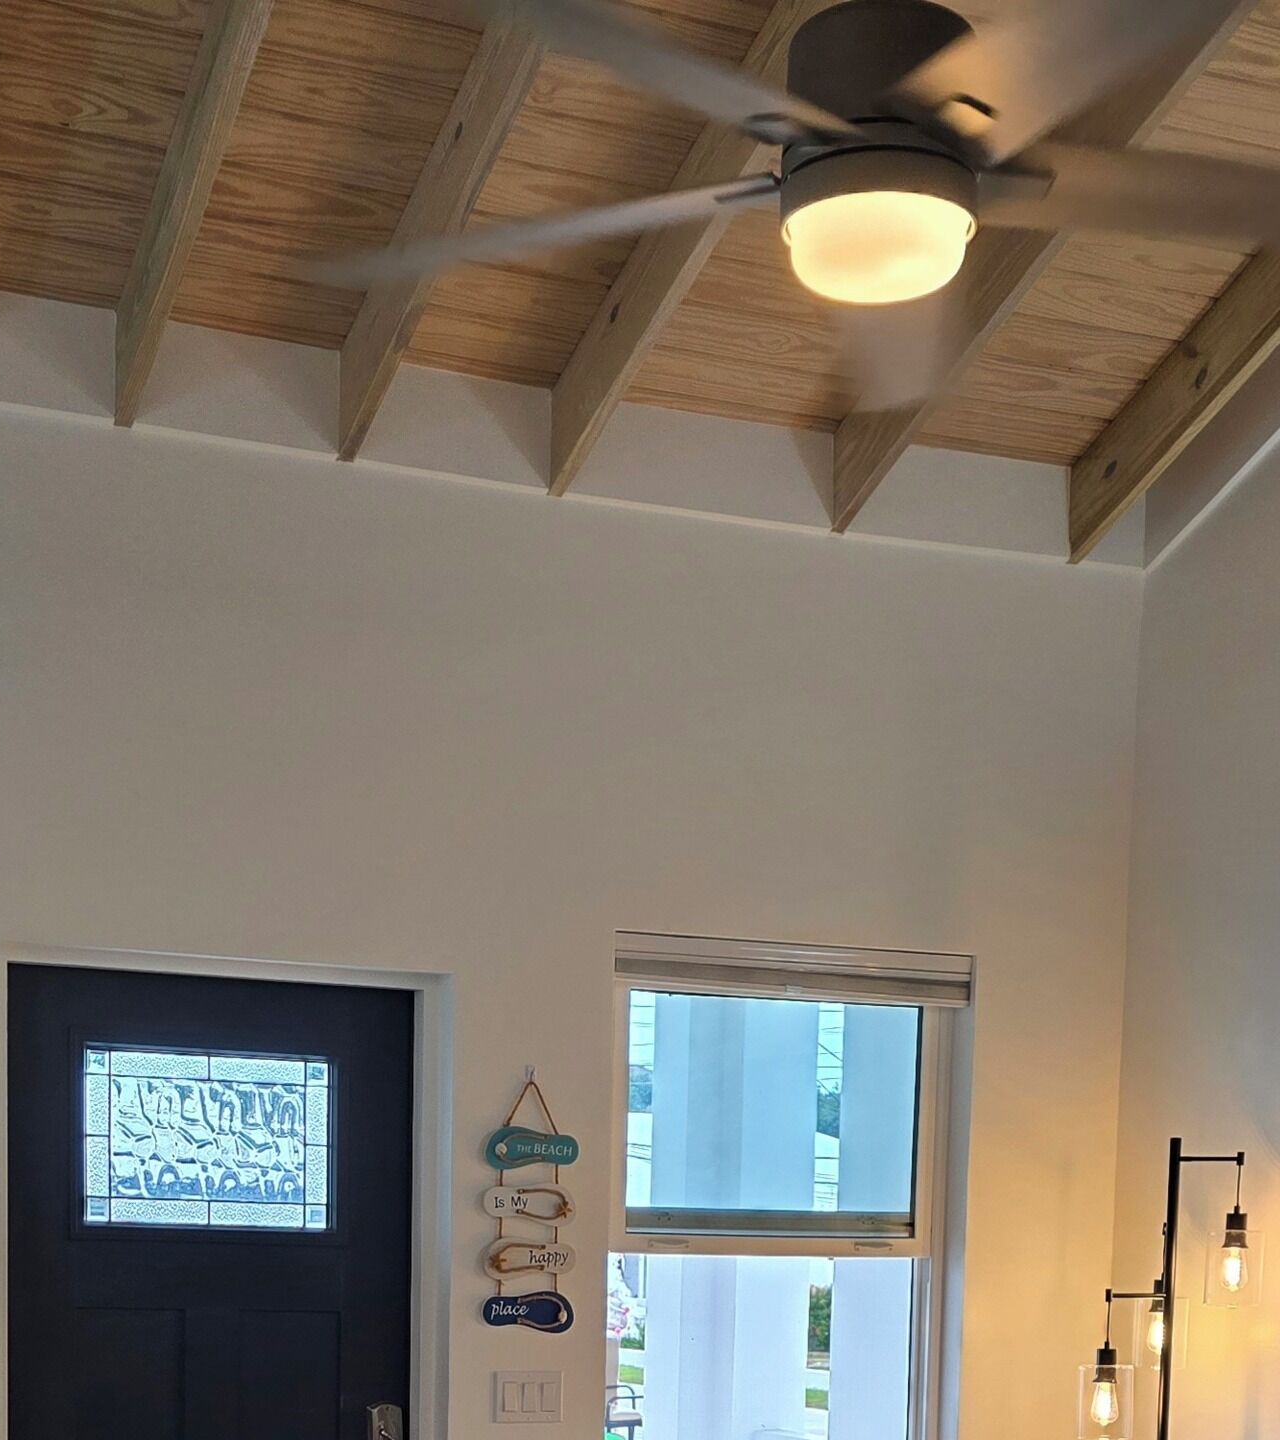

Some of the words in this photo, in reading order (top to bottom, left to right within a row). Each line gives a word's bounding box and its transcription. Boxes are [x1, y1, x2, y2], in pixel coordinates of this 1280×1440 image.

[517, 1143, 532, 1154] THE
[533, 1142, 573, 1157] BEACH
[494, 1196, 505, 1209] Is
[511, 1196, 529, 1209] My
[529, 1249, 569, 1267] happy
[490, 1301, 530, 1320] place
